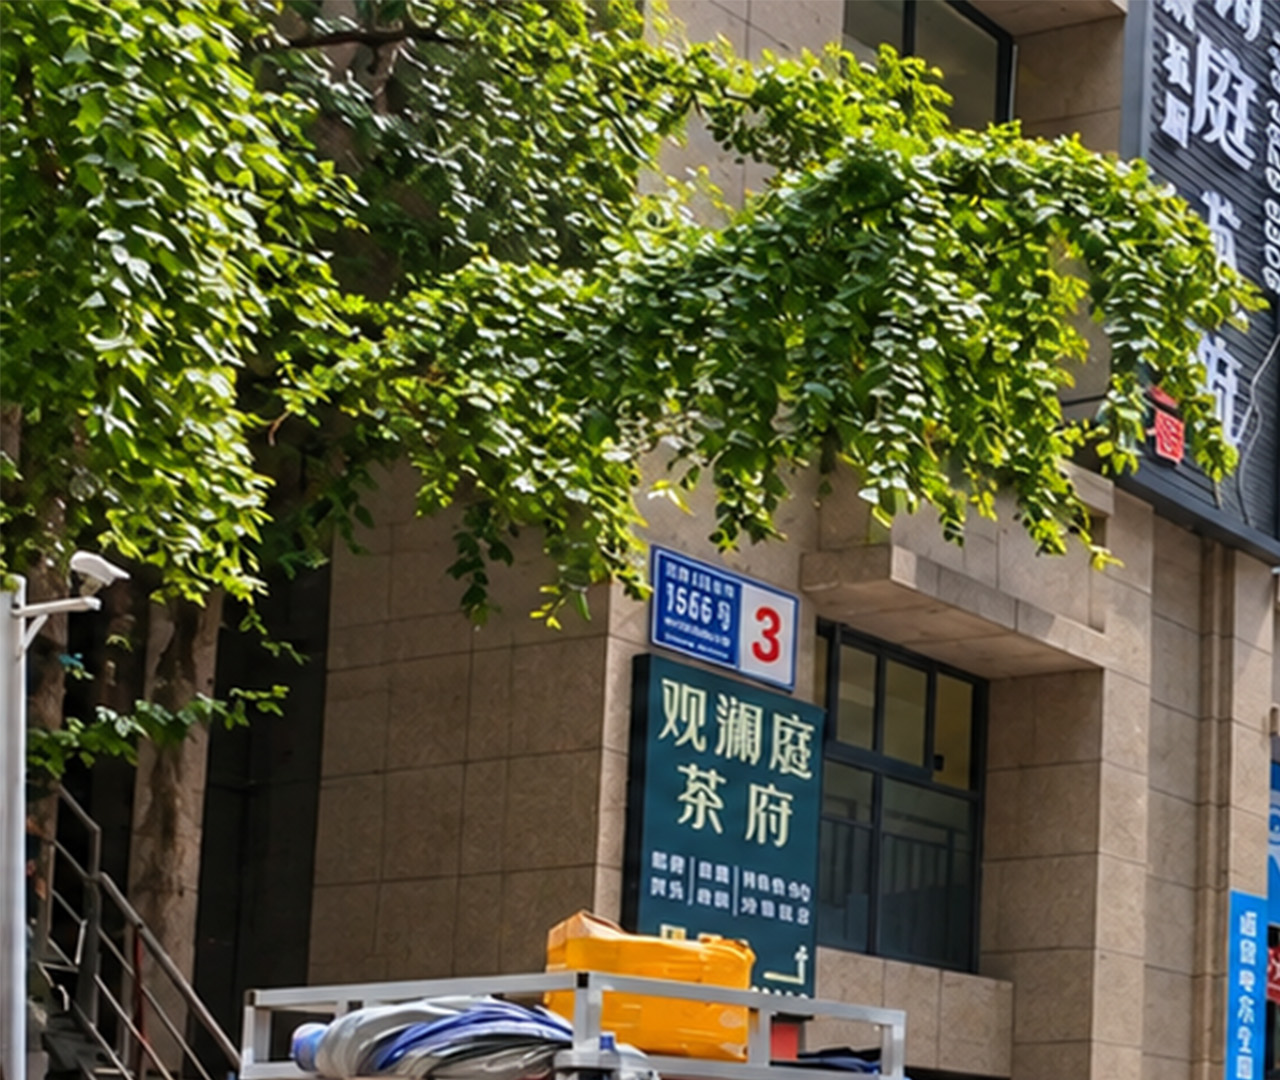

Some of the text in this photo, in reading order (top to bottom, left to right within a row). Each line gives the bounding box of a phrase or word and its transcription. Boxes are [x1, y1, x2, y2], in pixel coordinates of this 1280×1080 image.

[751, 606, 782, 664] 3
[658, 678, 815, 779] 观澜庭
[676, 762, 793, 847] 茶府
